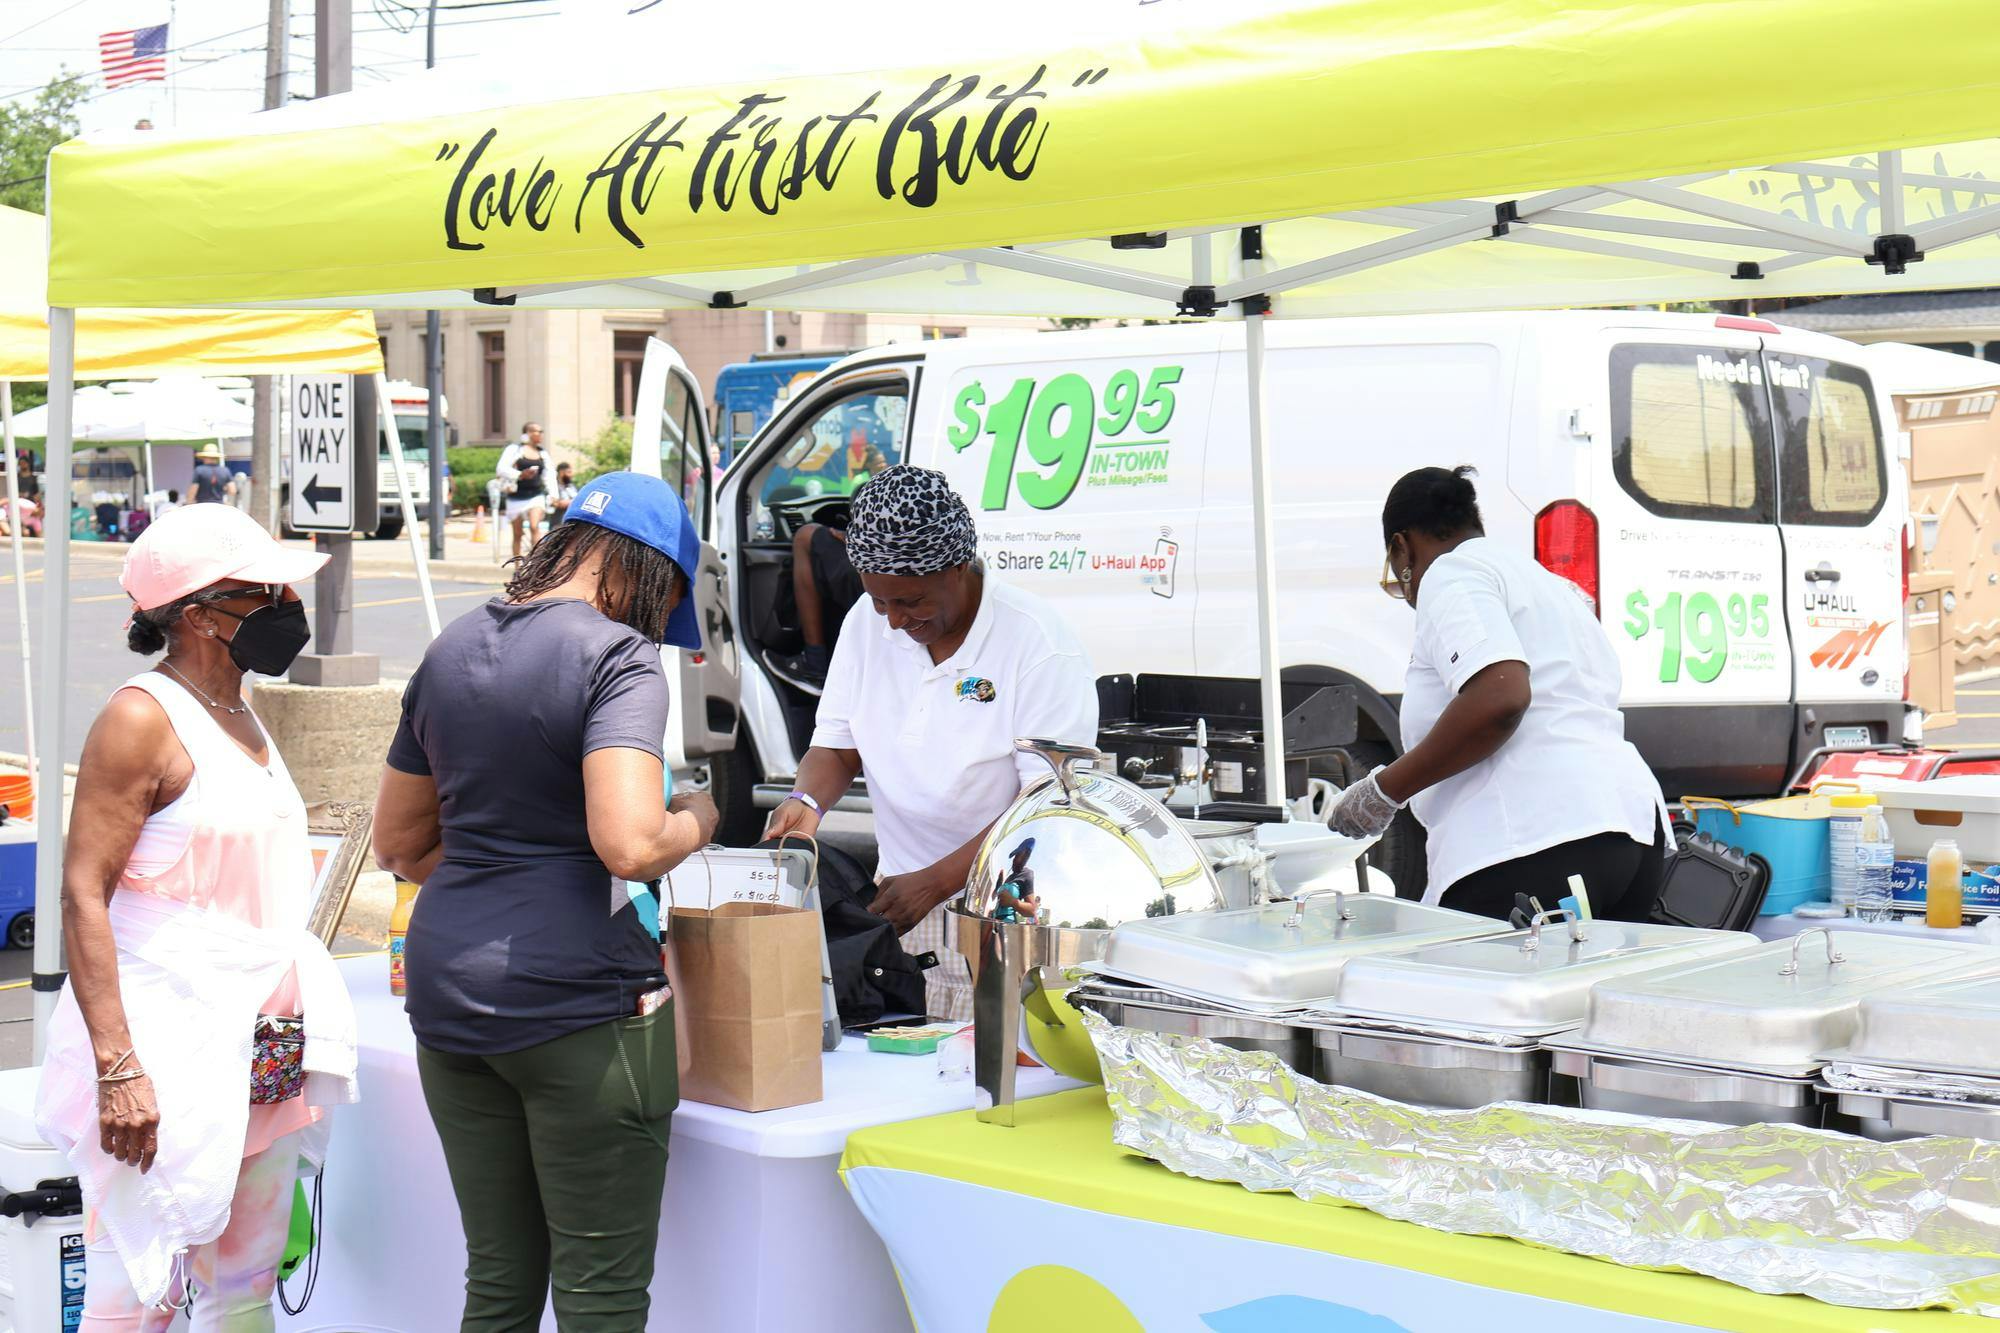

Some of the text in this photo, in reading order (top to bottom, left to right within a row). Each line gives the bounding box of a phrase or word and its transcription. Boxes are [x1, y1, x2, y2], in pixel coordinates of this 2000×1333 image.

[574, 112, 687, 249] At
[688, 91, 881, 215] First
[1696, 354, 1810, 390] Need a Van?
[299, 383, 343, 418] ONE
[298, 428, 345, 463] WAY
[1090, 449, 1169, 474] IN-TOWN
[1087, 475, 1107, 487] Plus
[1005, 532, 1024, 542] Rent
[1055, 531, 1081, 542] Phone
[1620, 529, 1648, 541] Drive
[996, 551, 1044, 570] Share
[1049, 547, 1087, 574] 24/7
[1091, 555, 1136, 570] U-Haul
[1140, 555, 1166, 572] App
[1980, 884, 2000, 895] Foil
